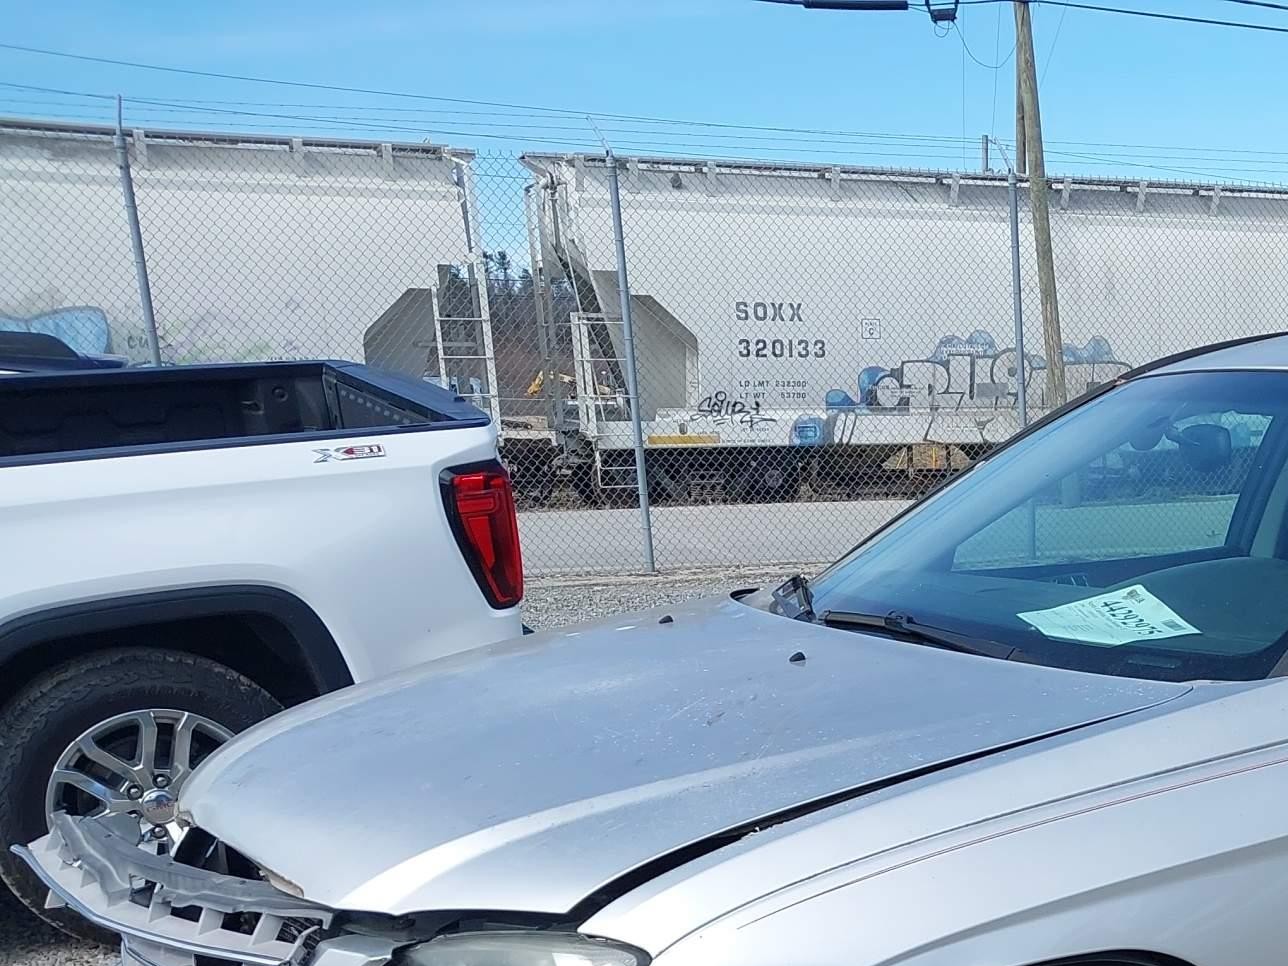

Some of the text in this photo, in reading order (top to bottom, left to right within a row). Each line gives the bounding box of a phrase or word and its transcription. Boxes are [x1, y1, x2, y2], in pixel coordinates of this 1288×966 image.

[735, 301, 803, 322] SOXX
[738, 338, 826, 359] 320133
[1100, 600, 1164, 636] 44292975
